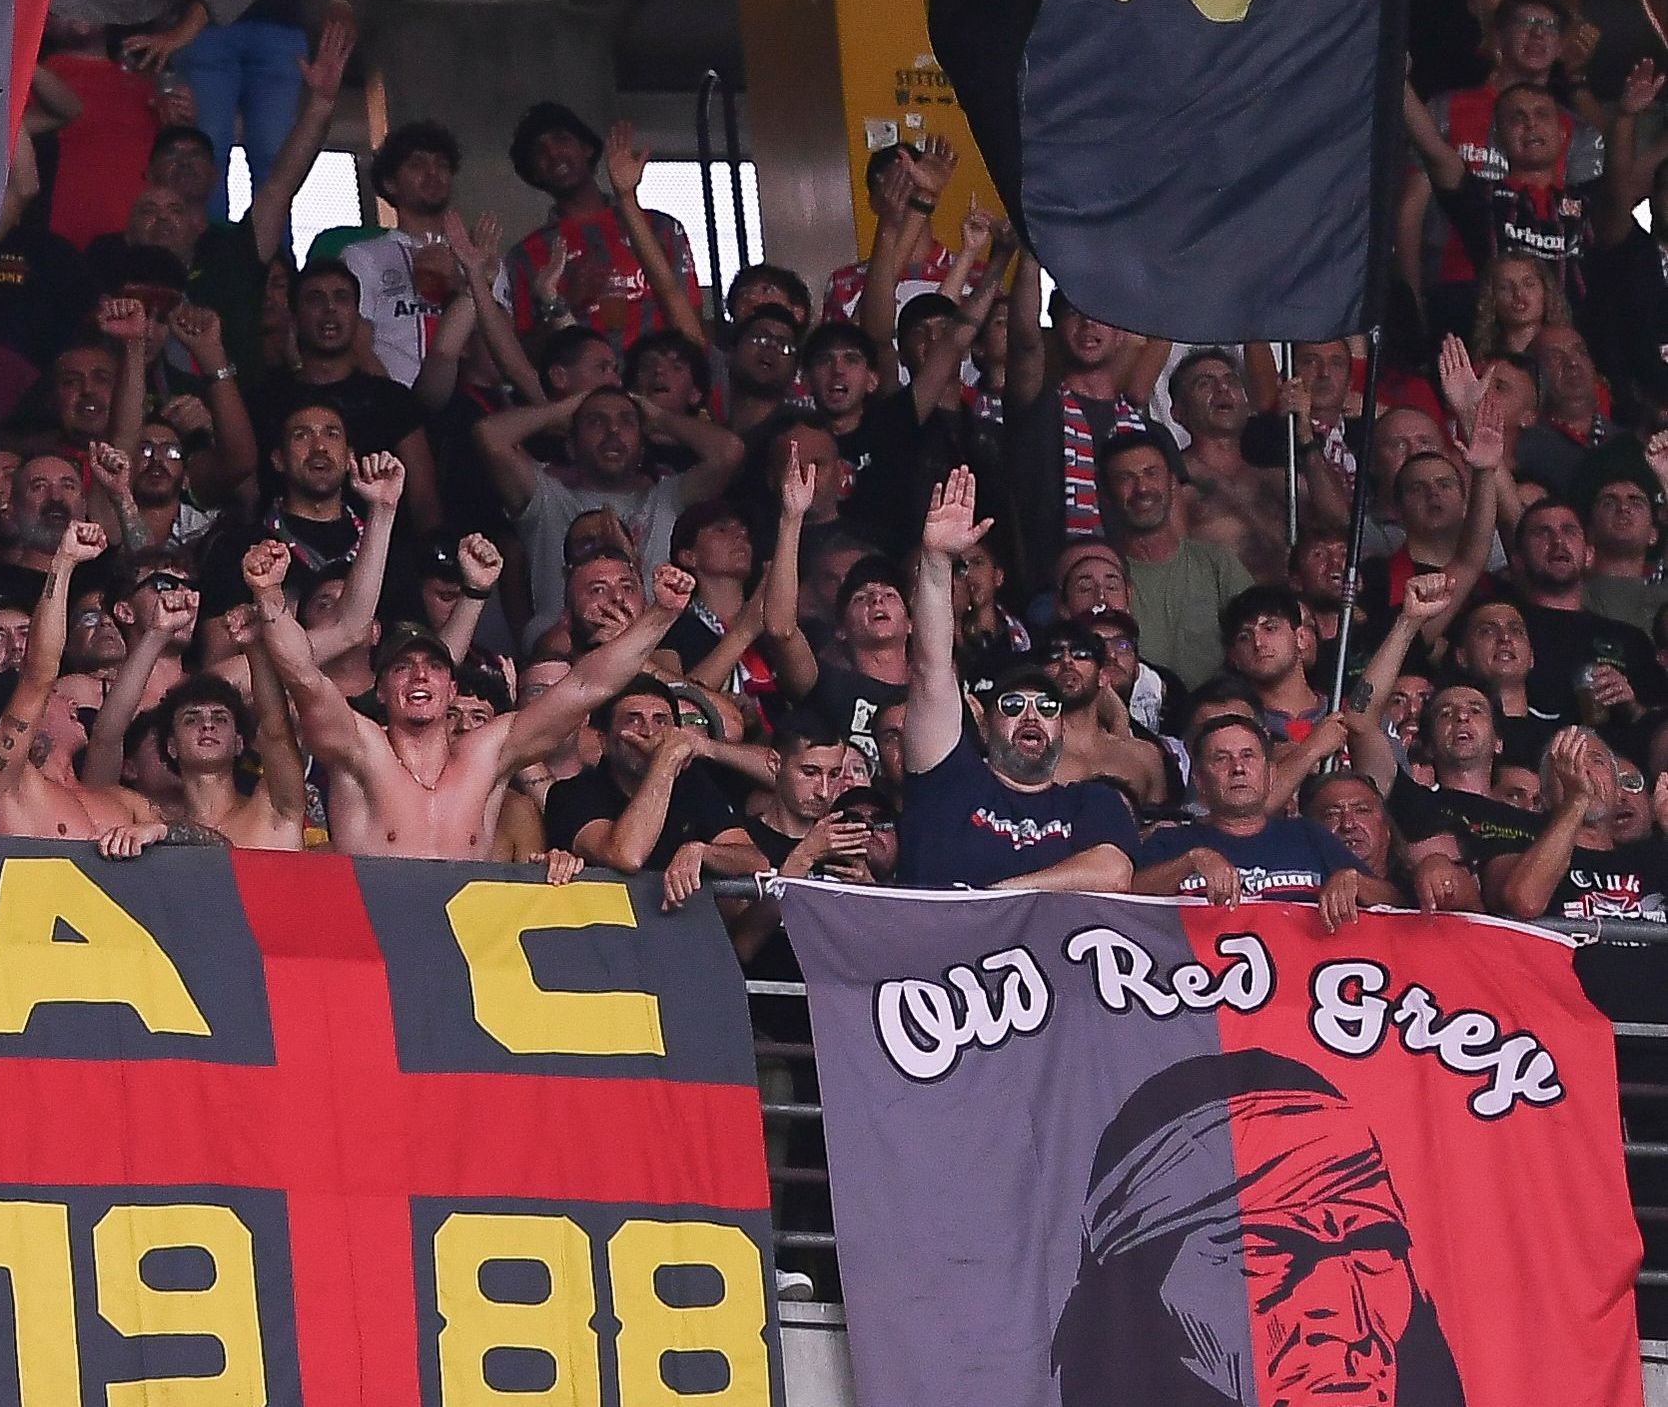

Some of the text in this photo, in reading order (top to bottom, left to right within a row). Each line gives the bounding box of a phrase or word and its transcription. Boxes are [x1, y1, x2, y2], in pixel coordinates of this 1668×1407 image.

[875, 926, 1566, 1119] Old Red Grey
